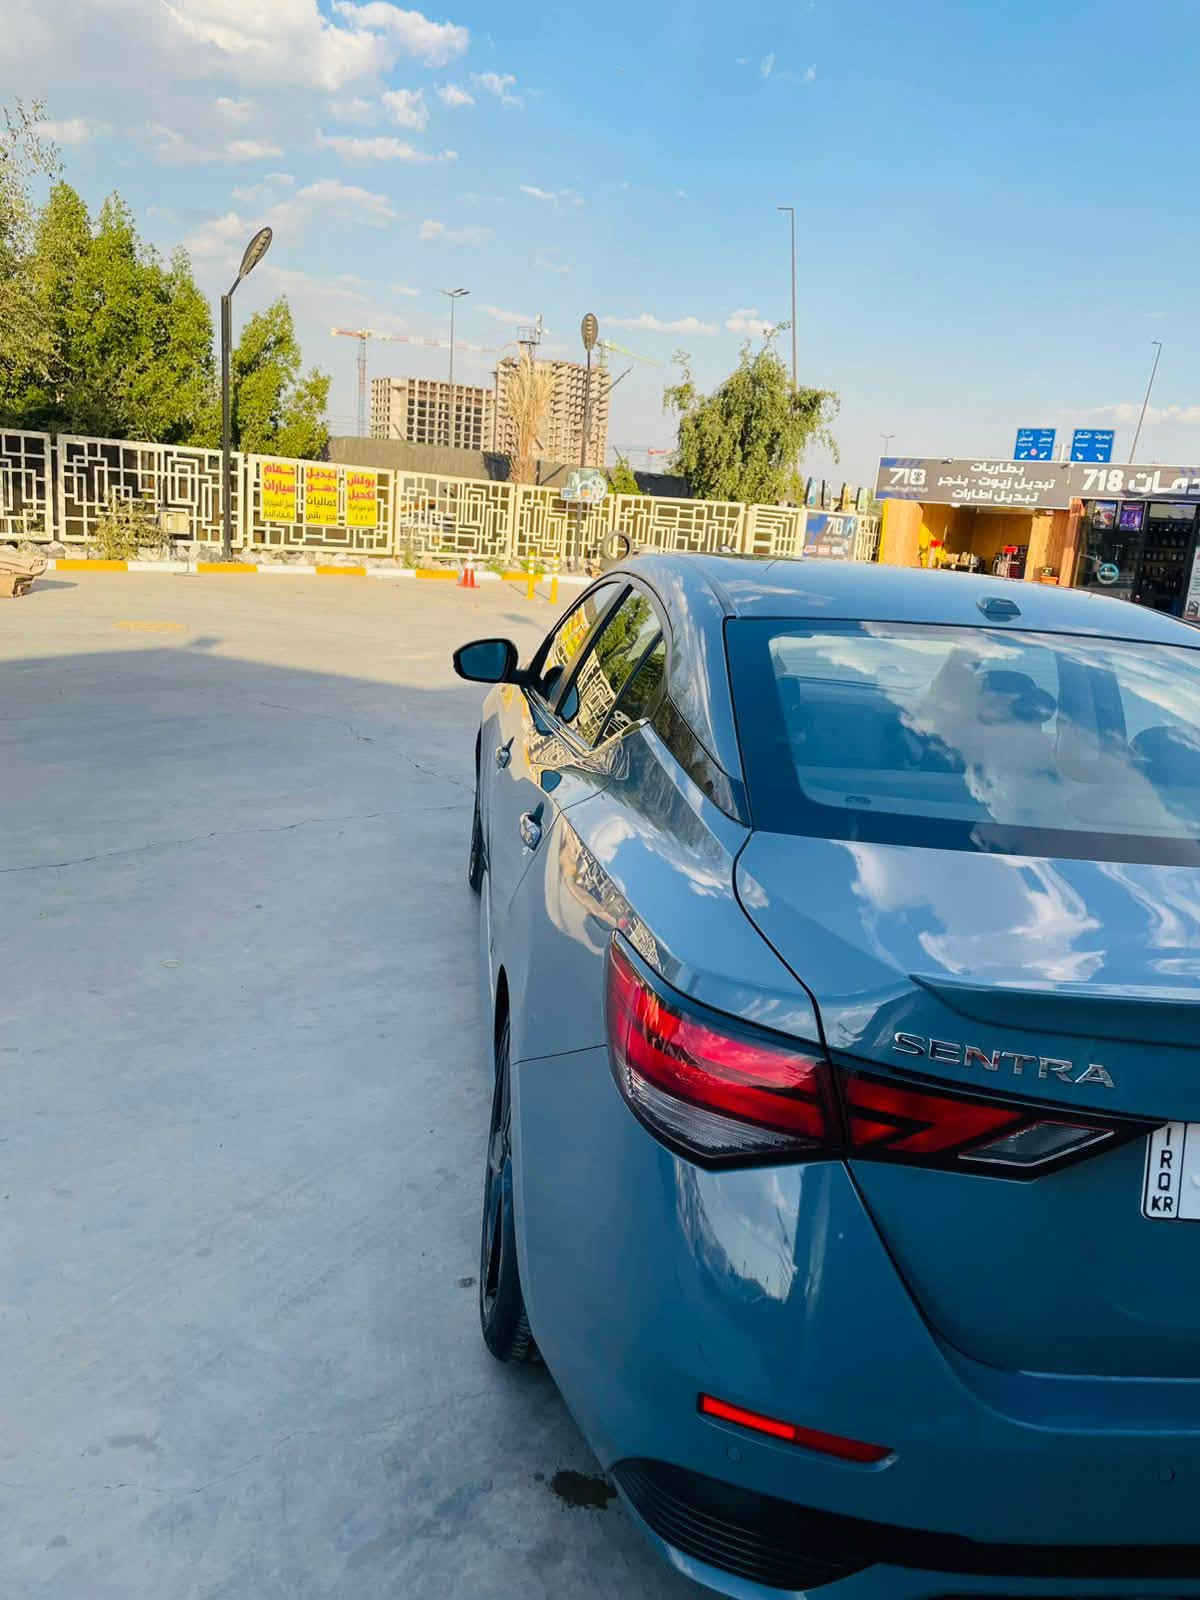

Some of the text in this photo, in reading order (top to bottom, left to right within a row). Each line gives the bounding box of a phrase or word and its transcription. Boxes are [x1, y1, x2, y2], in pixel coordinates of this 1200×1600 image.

[264, 463, 295, 475] حمام
[306, 467, 337, 480] تبديل
[970, 462, 1025, 475] بطاريات
[347, 474, 375, 488] بولش
[889, 468, 926, 485] 718
[978, 475, 1012, 488] زيوت
[1081, 468, 1125, 492] 718
[264, 479, 295, 495] سيارات
[1014, 477, 1056, 491] تبديل
[306, 495, 337, 508] كماليات
[994, 489, 1039, 503] تبديل
[892, 1032, 1116, 1088] SENTRA
[1158, 1127, 1173, 1192] IRQ
[1151, 1195, 1174, 1213] KR
